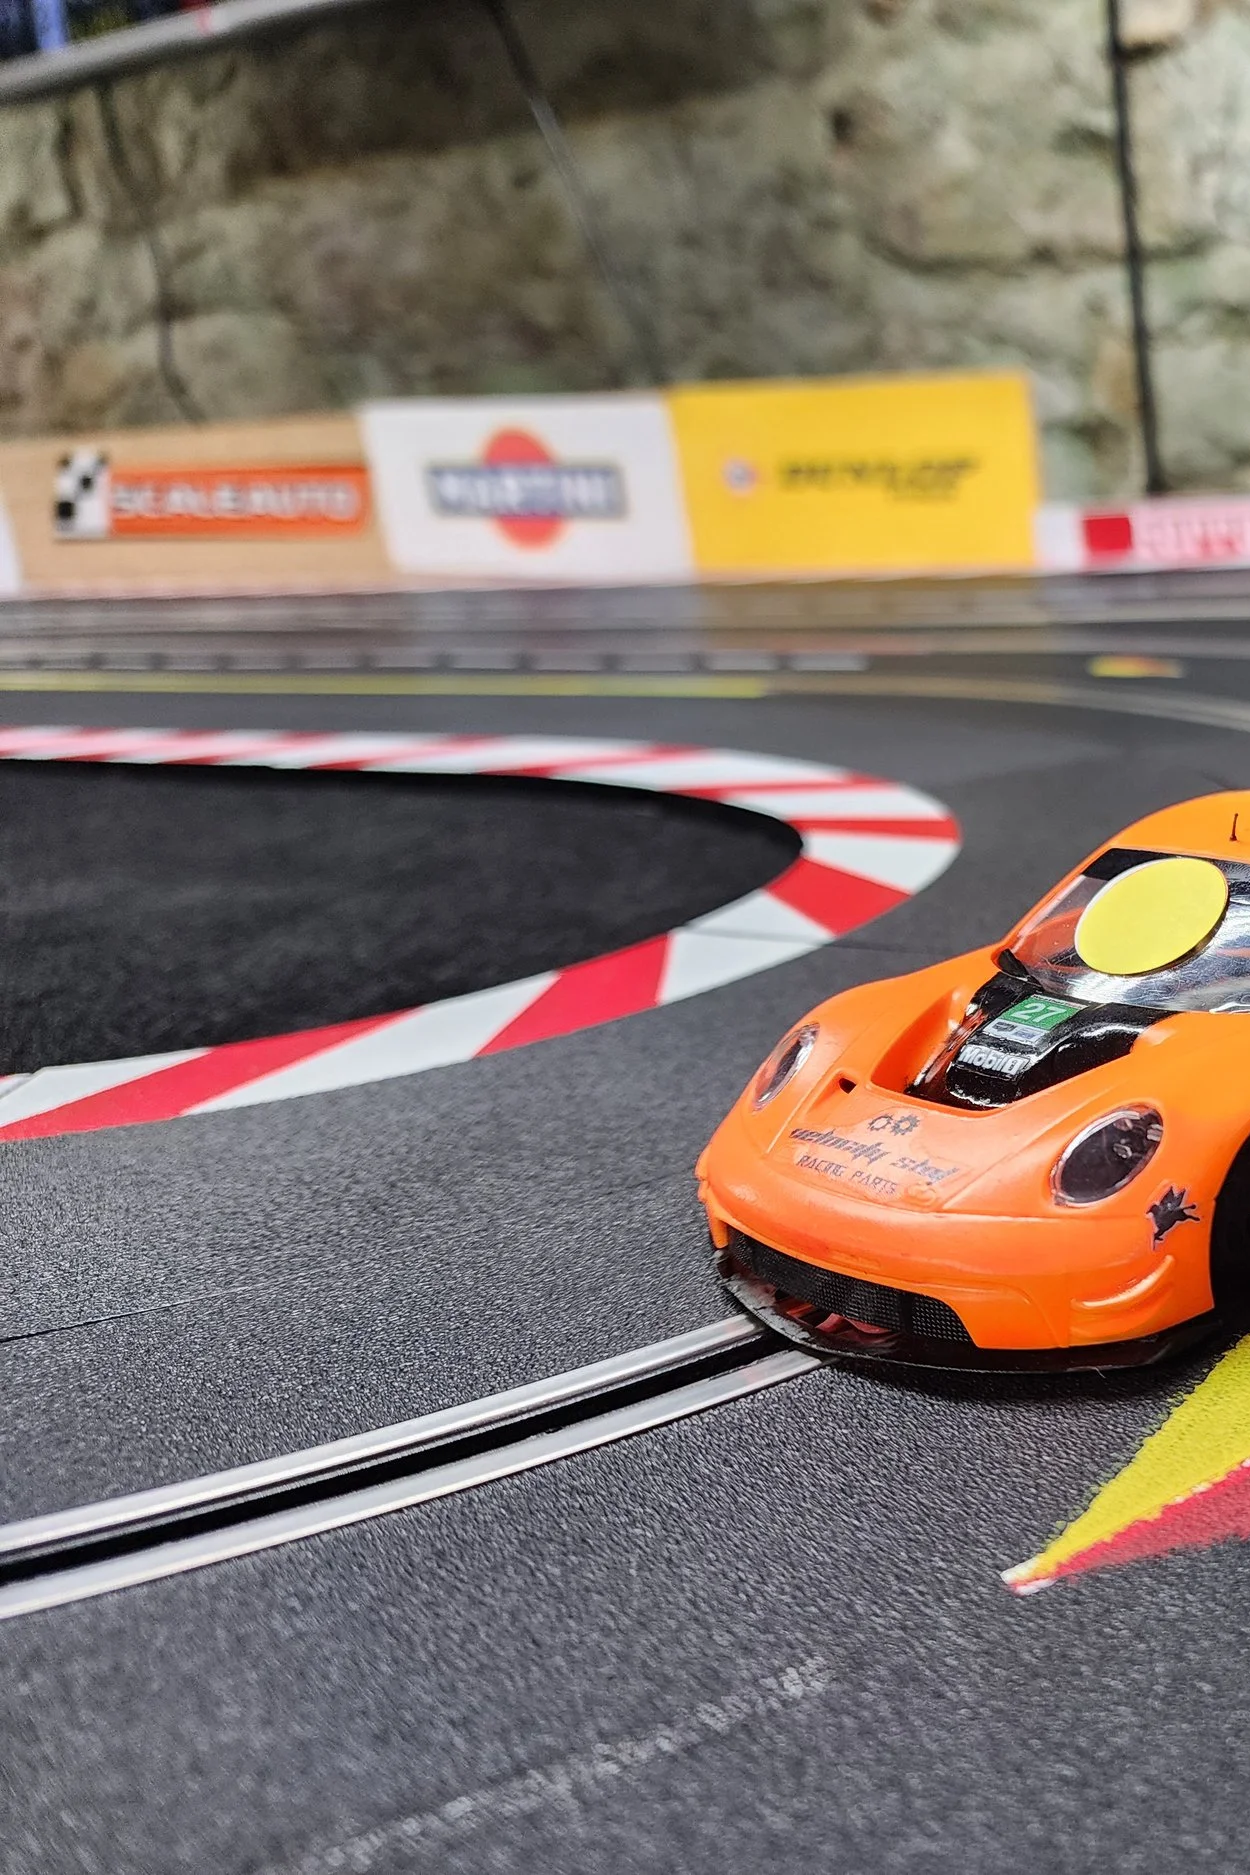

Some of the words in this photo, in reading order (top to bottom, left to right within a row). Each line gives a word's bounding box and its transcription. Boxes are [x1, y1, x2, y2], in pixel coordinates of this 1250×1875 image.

[112, 482, 364, 520] SCALEAUTO
[434, 471, 612, 512] MARTINI
[1010, 1002, 1068, 1023] 27
[796, 1155, 849, 1178] RACING
[850, 1170, 899, 1195] PARTS
